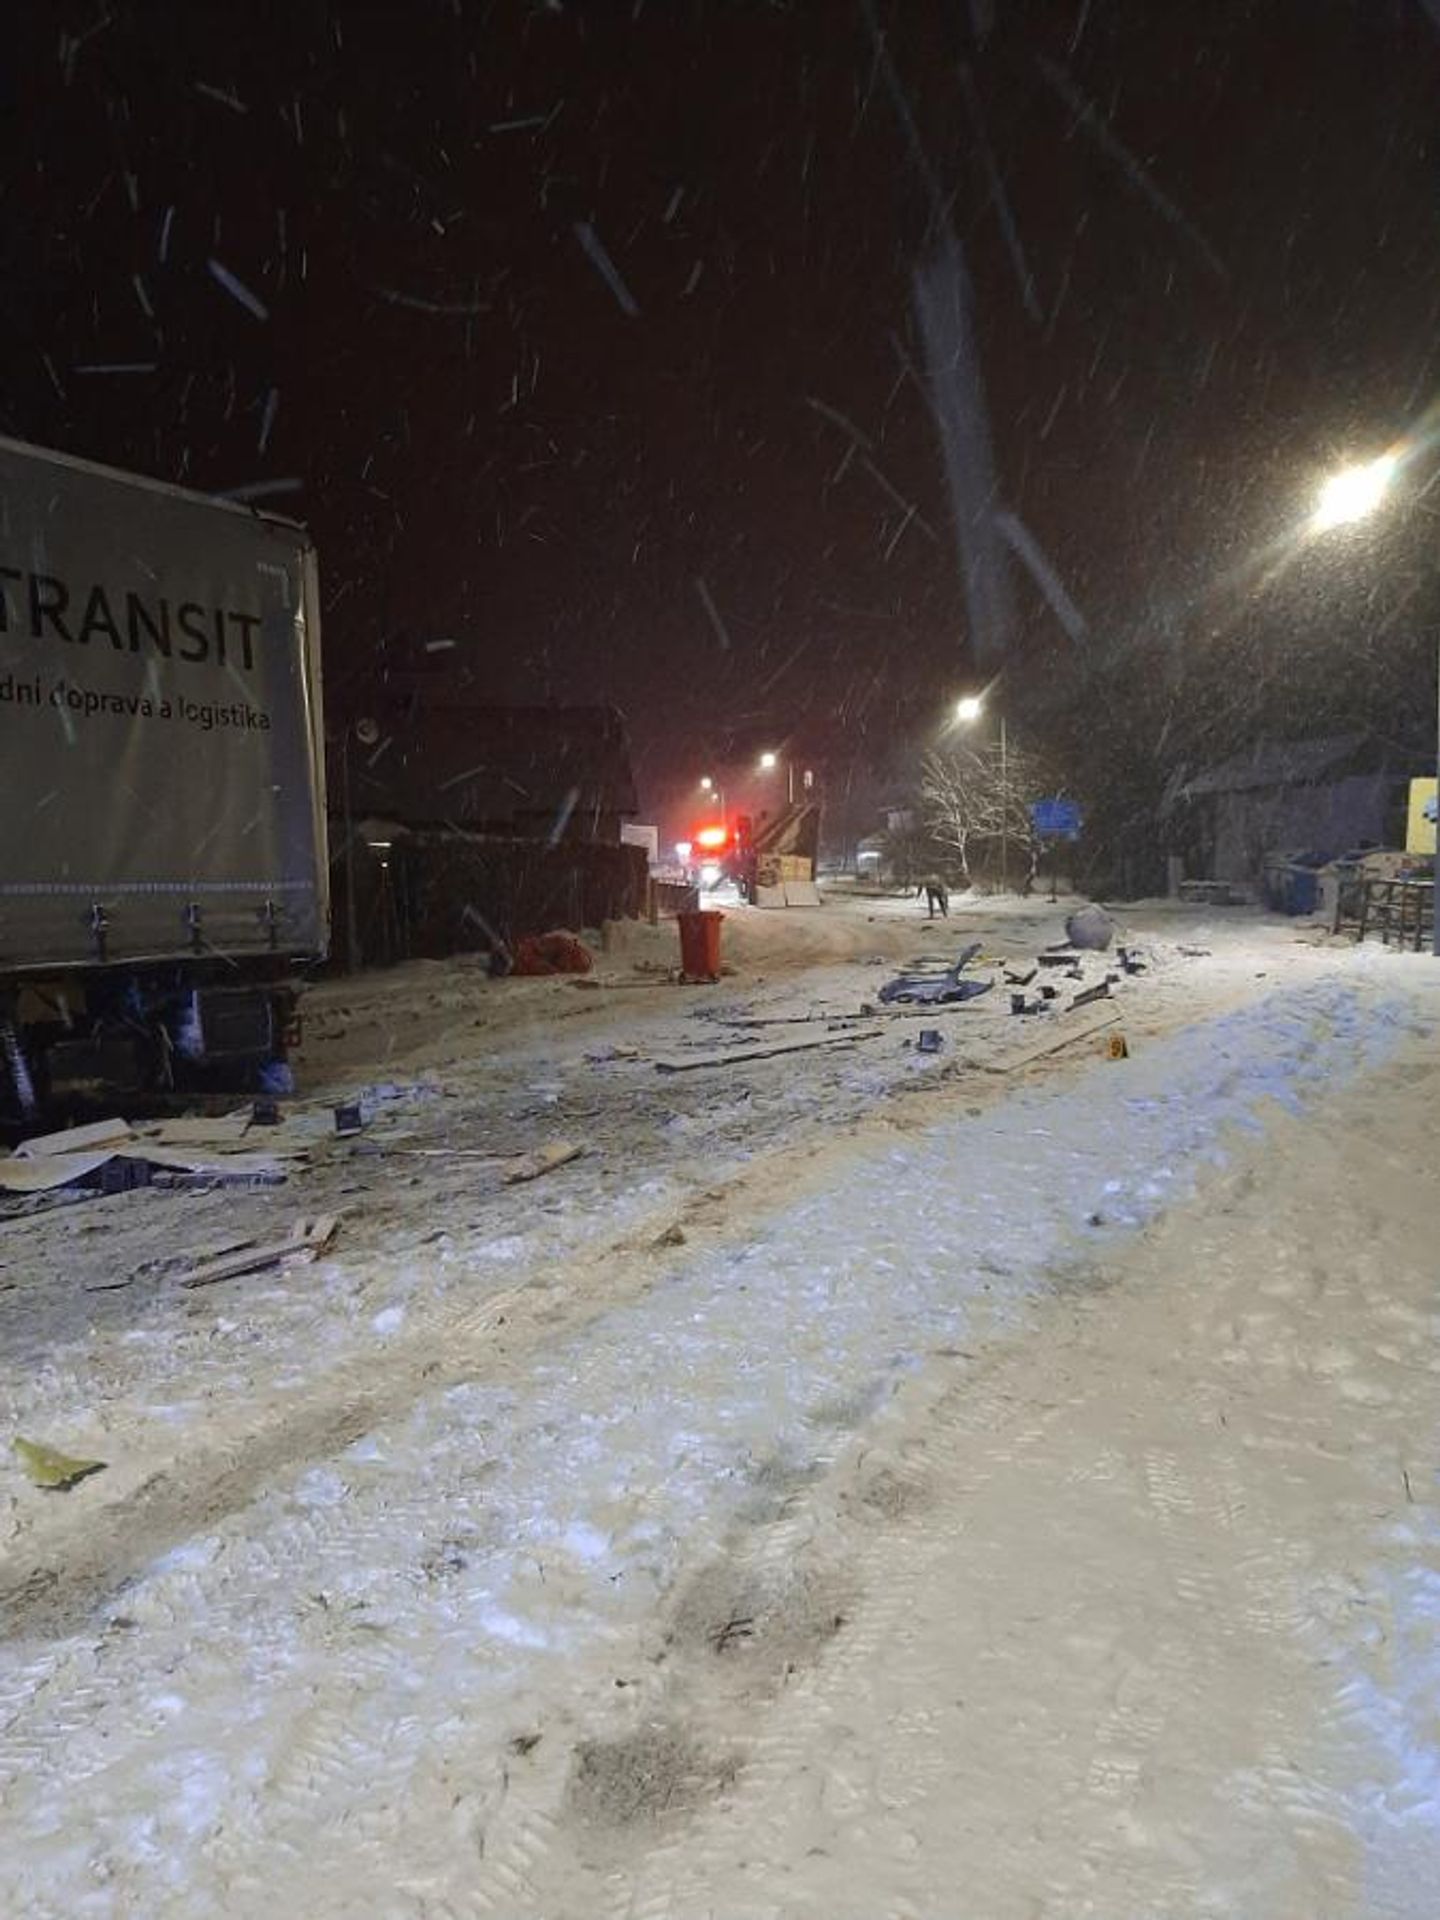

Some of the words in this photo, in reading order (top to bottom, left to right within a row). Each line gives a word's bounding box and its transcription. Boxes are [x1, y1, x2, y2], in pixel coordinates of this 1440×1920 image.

[0, 567, 262, 670] TRANSIT
[50, 681, 153, 718] doprava
[159, 698, 172, 718] a
[178, 697, 272, 731] logistika
